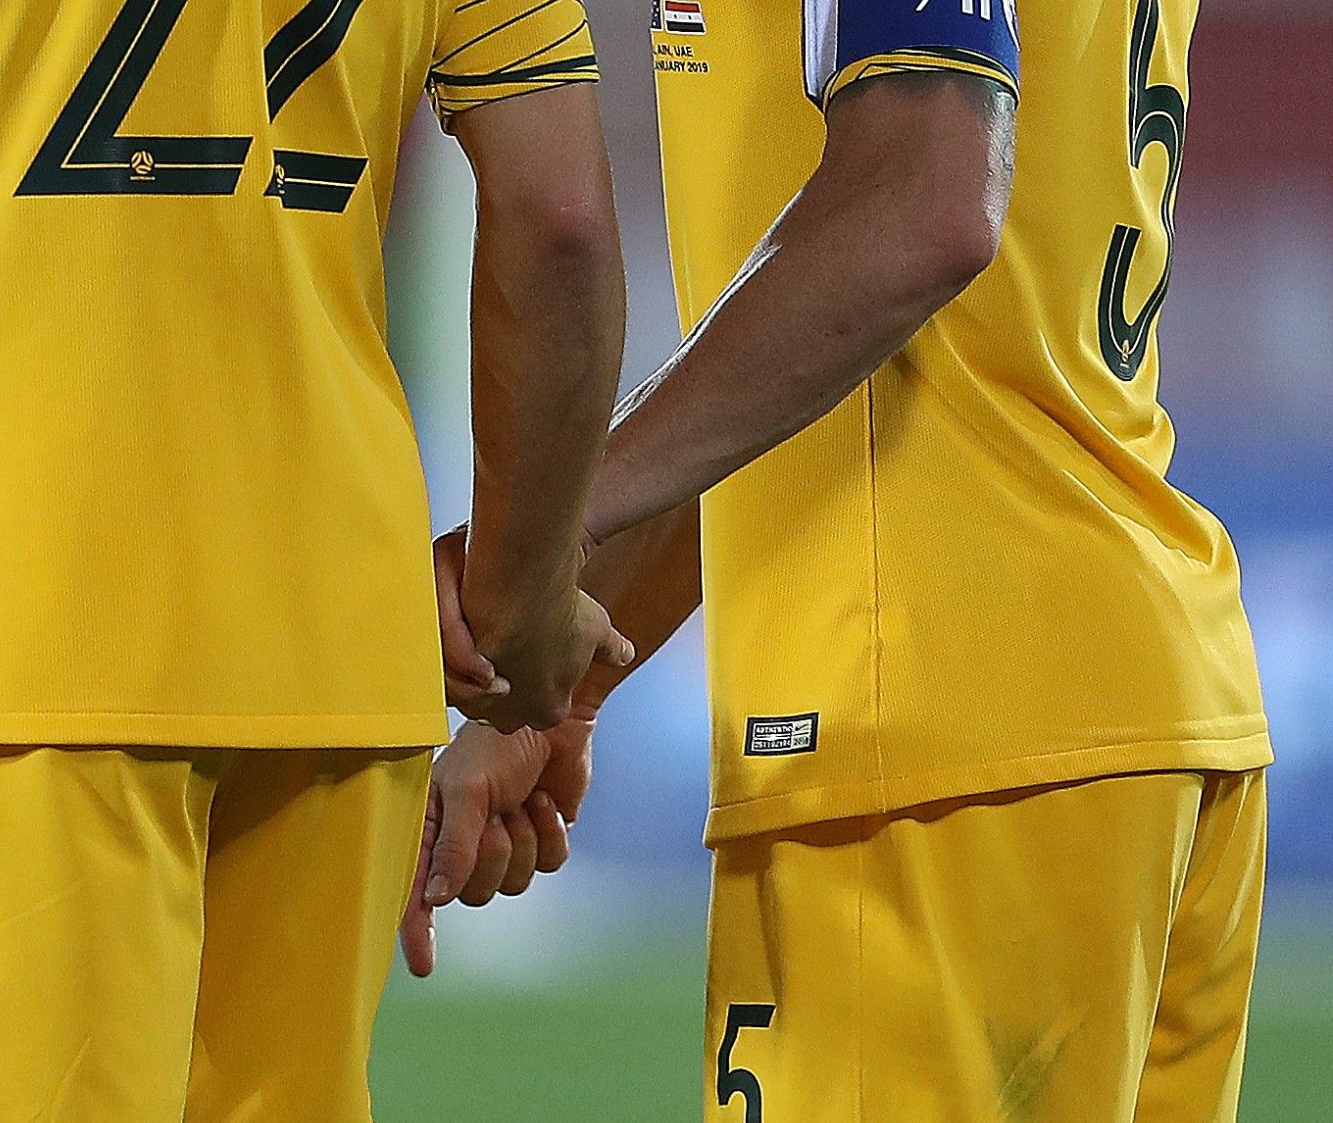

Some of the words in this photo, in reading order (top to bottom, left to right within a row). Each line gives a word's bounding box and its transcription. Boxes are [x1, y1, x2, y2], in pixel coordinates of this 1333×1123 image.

[674, 45, 693, 57] UAE
[687, 61, 708, 73] 2019
[717, 1003, 776, 1123] 5
